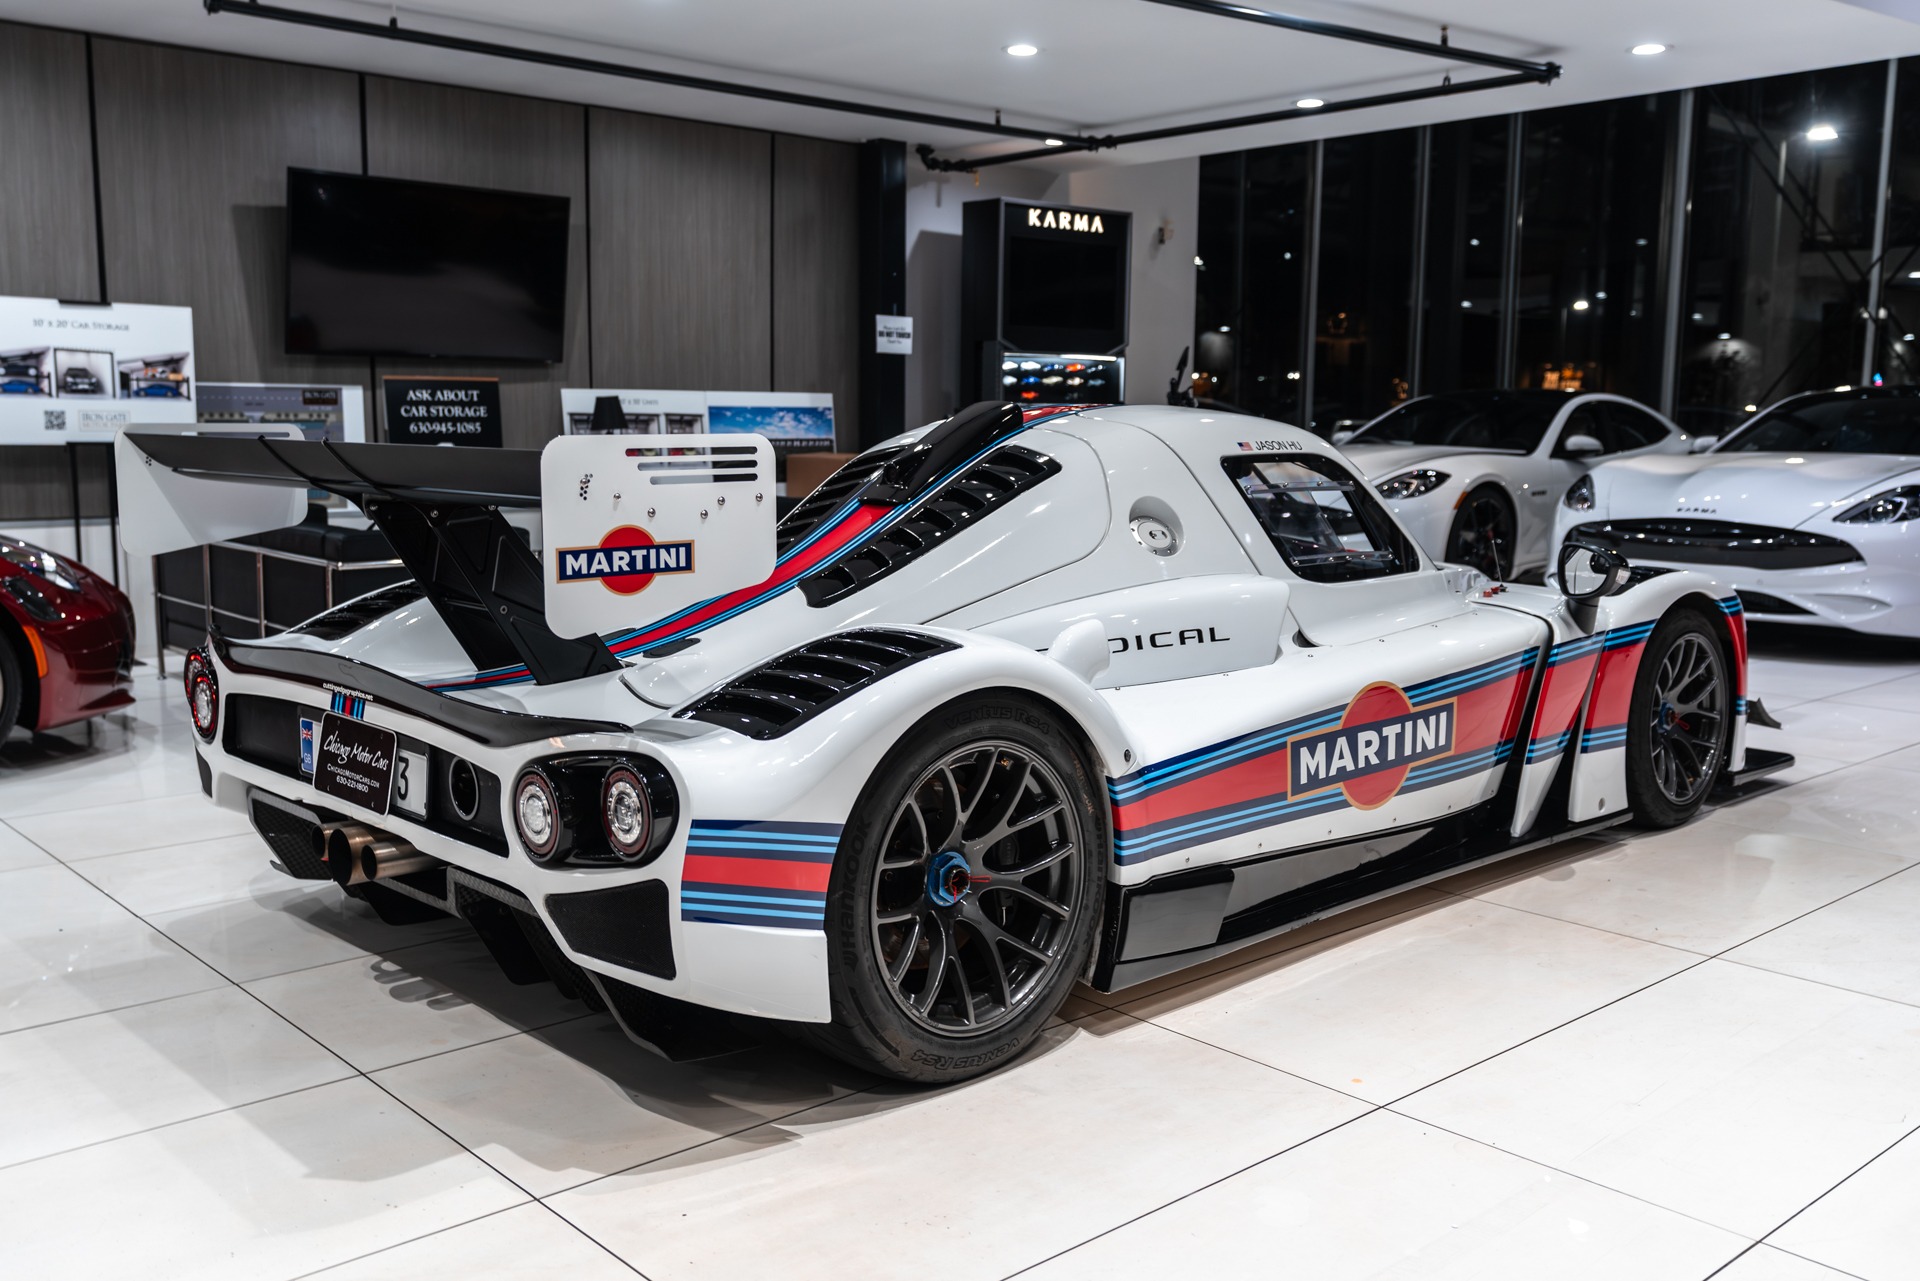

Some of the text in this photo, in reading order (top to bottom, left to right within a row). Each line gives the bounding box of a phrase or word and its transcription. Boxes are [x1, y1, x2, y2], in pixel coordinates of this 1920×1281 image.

[1028, 208, 1104, 234] KARMA
[407, 389, 479, 401] ASK ABOUT
[401, 405, 488, 417] CAR STORAGE
[409, 421, 482, 434] 630-945-1085
[1255, 440, 1303, 451] JASON HU
[565, 546, 687, 576] MARTINI
[1107, 626, 1231, 654] DICAL
[303, 752, 312, 764] GB
[323, 730, 389, 771] Chicago Motor Cars
[1300, 711, 1448, 785] MARTINI
[336, 776, 369, 793] 630-221-1800
[397, 755, 410, 801] 3
